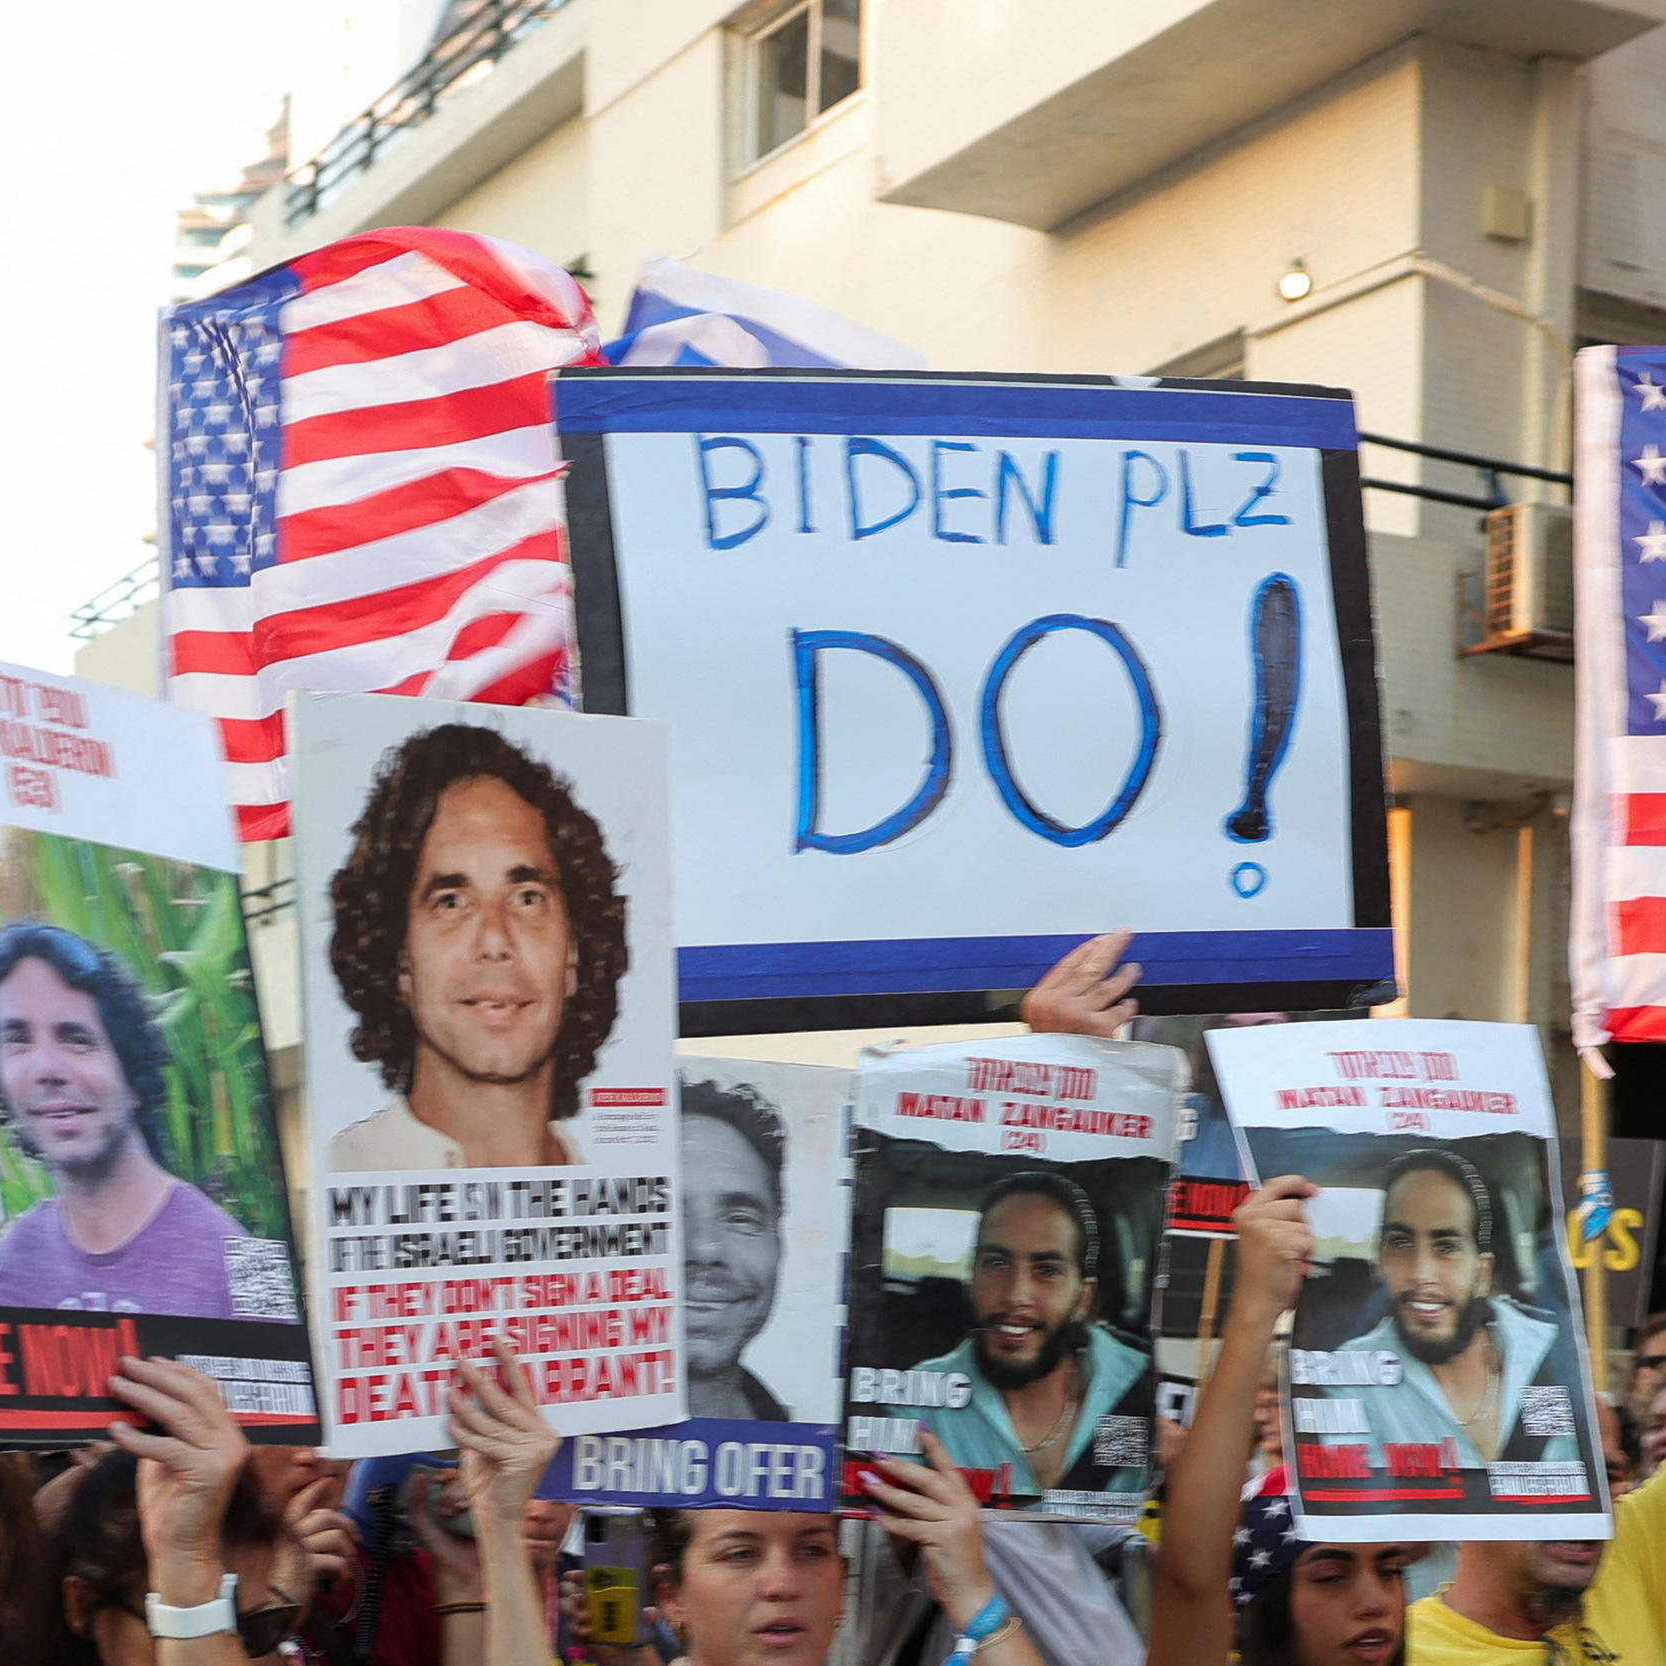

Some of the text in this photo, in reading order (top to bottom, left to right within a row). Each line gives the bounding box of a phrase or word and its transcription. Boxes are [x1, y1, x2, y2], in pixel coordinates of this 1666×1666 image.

[695, 432, 1293, 570] BIDEN PLZ
[790, 570, 1305, 900] DO!
[895, 1091, 988, 1123] MATAN
[997, 1100, 1156, 1139] ZANGAUKER
[1276, 1085, 1522, 1115] MATAN ZANGAUKER
[1000, 1130, 1049, 1153] (24)
[329, 1185, 380, 1228] MY
[387, 1182, 457, 1225] LIFE
[507, 1179, 566, 1219] THE
[569, 1176, 672, 1217] HANDS
[391, 1227, 495, 1271] ISRAELI
[499, 1221, 671, 1265] GOVERNMENT
[333, 1286, 360, 1323] IF
[364, 1280, 438, 1321] THEY
[522, 1271, 580, 1309] SIGN
[583, 1270, 606, 1305] A
[335, 1306, 673, 1371] THEY ARE SIGNING MY
[849, 1366, 973, 1409] BRING
[1288, 1349, 1404, 1387] BRING
[846, 1415, 923, 1455] HIM
[1293, 1397, 1372, 1434] HIM
[572, 1435, 707, 1496] BRING
[713, 1441, 828, 1501] OFER
[1296, 1442, 1375, 1479] HOME
